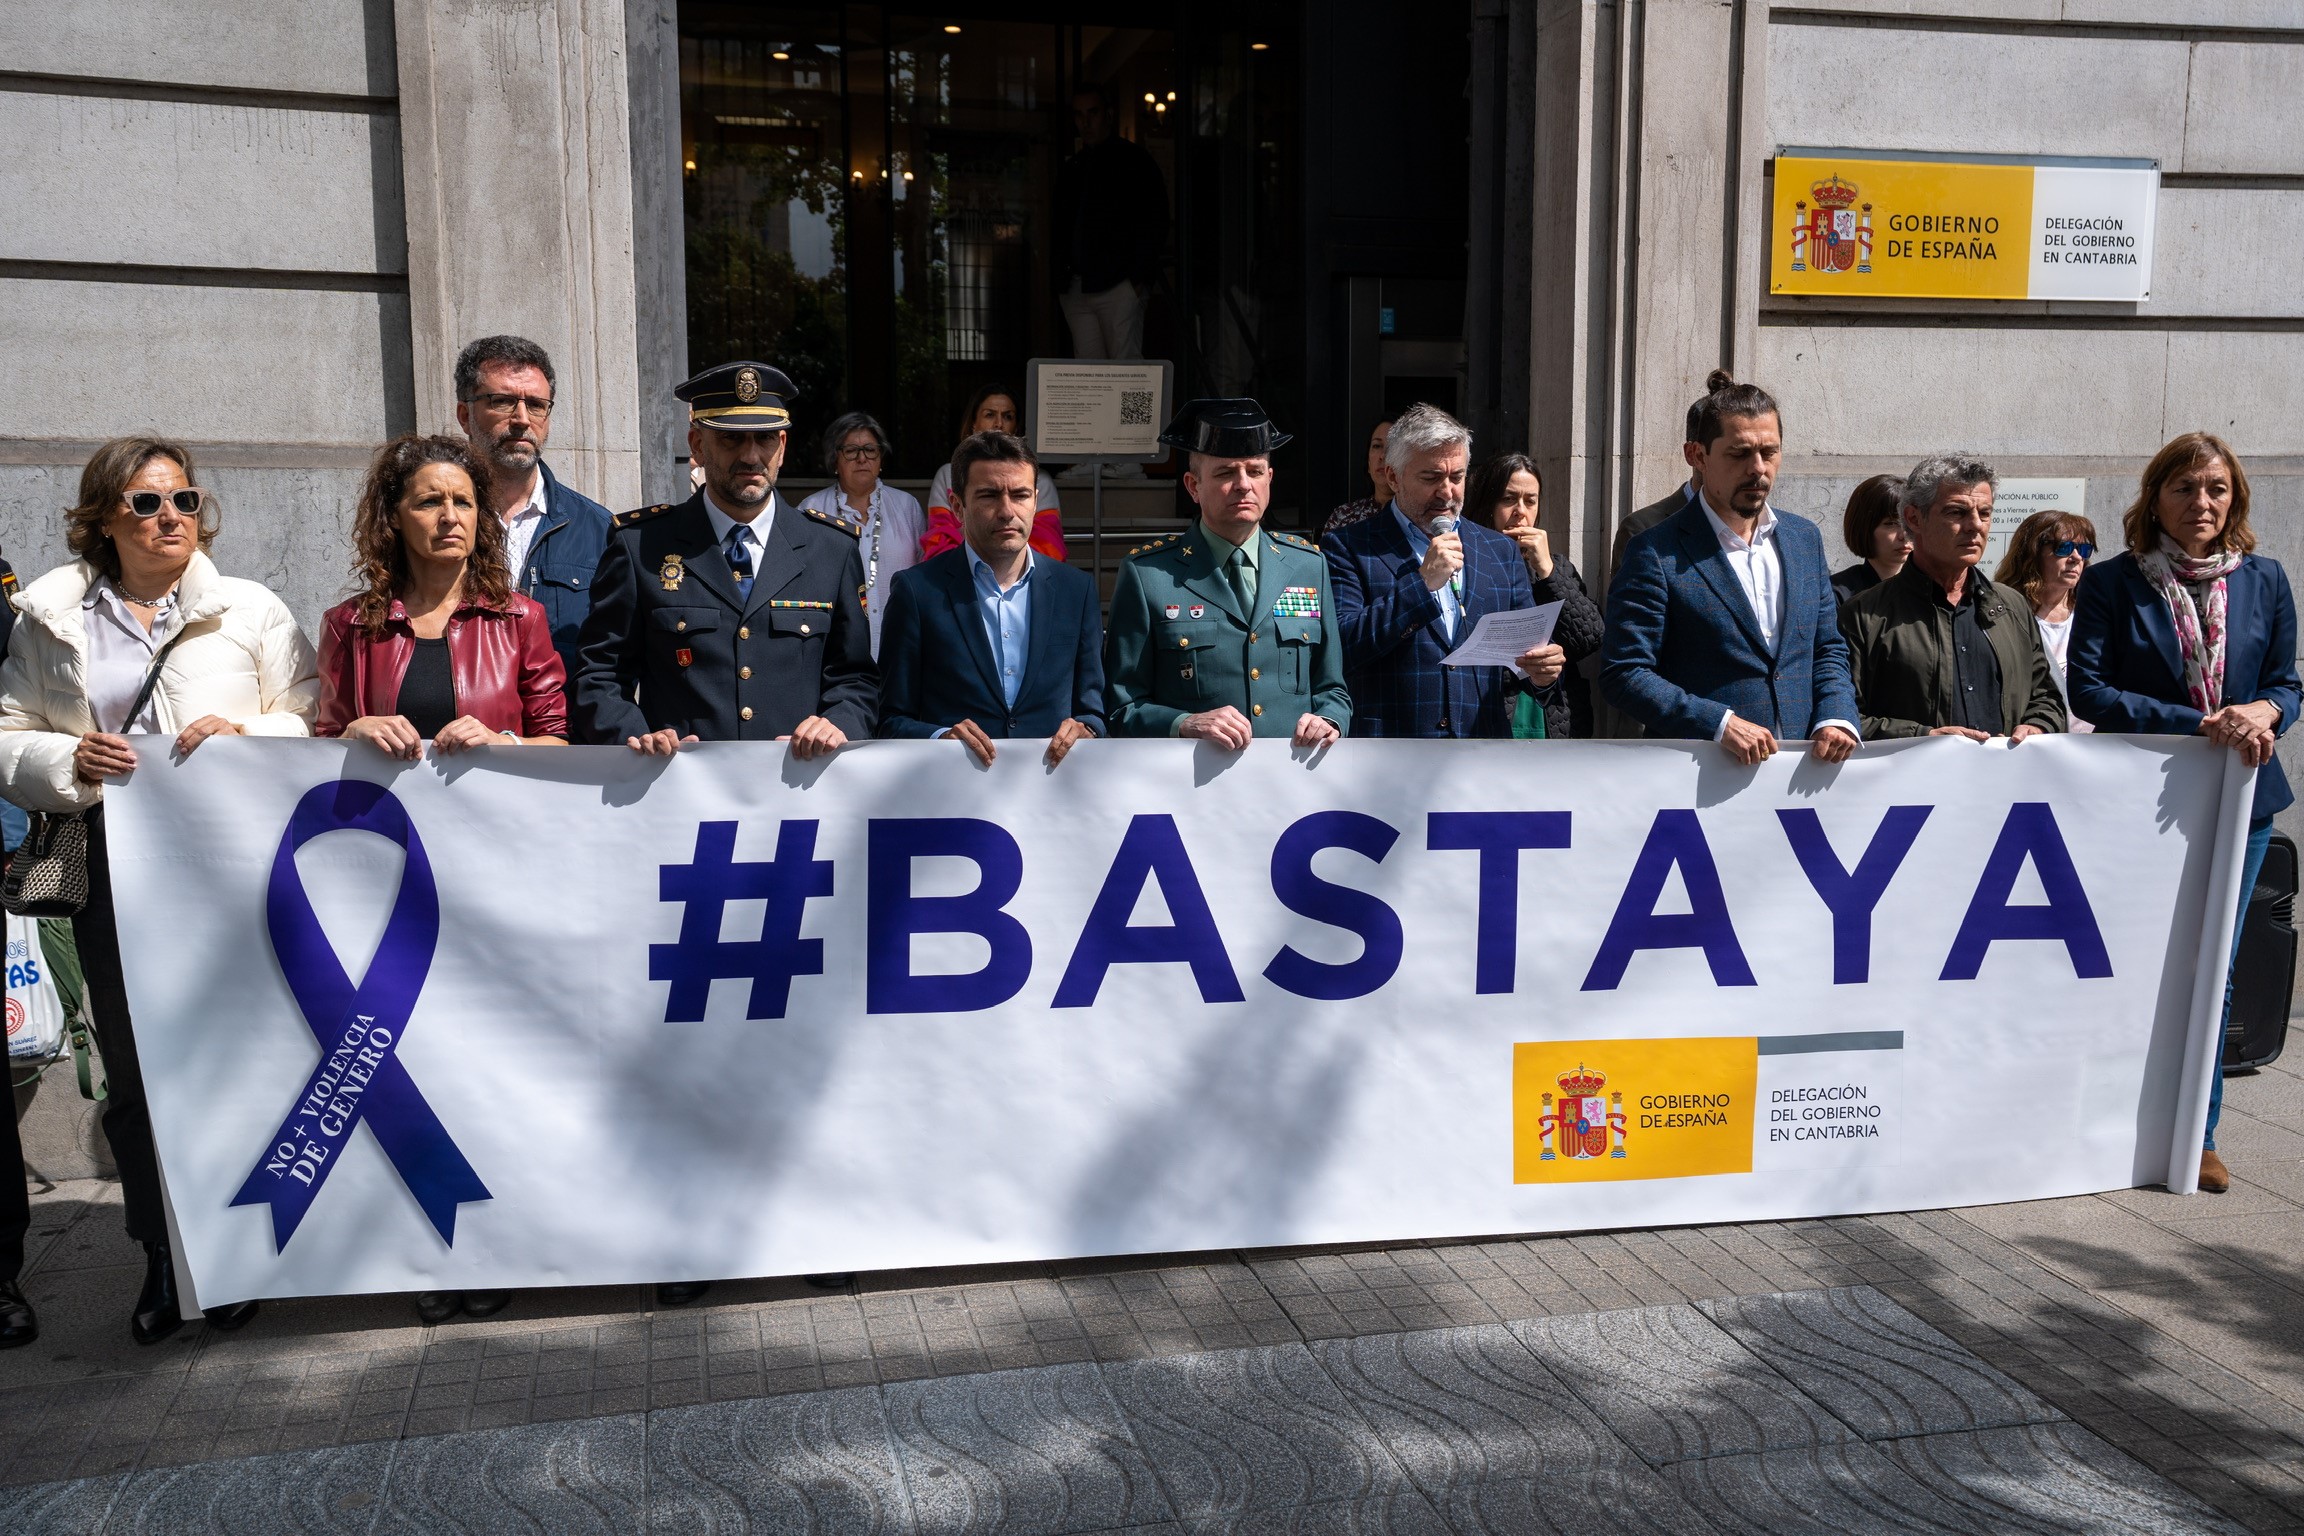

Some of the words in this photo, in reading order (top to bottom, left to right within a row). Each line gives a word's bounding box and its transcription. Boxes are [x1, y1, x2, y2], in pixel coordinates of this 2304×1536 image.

[1889, 214, 1999, 234] GOBIERNO
[2045, 215, 2123, 231] DELEGACIÓN
[1888, 240, 1913, 258] DE
[1921, 238, 1997, 260] ESPAÑA
[2044, 234, 2067, 247] DEL
[2072, 234, 2135, 248] GOBIERNO
[2043, 251, 2059, 263] EN
[2064, 251, 2137, 265] CANTABRIA
[2031, 492, 2059, 500] PÚBLICO
[648, 802, 2114, 1023] #BASTAYA
[265, 1142, 296, 1179] NO
[300, 1014, 375, 1118] VIOLENCIA
[1639, 1093, 1730, 1111] GOBIERNO
[1771, 1084, 1867, 1103] DELEGACIÓN
[289, 1140, 329, 1188] DE
[319, 1027, 392, 1137] GENERO
[1770, 1108, 1798, 1122] DEL
[1802, 1105, 1881, 1121] GOBIERNO
[1640, 1114, 1662, 1129] DE
[1667, 1110, 1728, 1128] ESPAÑA
[1770, 1128, 1790, 1142] EN
[1795, 1124, 1880, 1141] CANTABRIA
